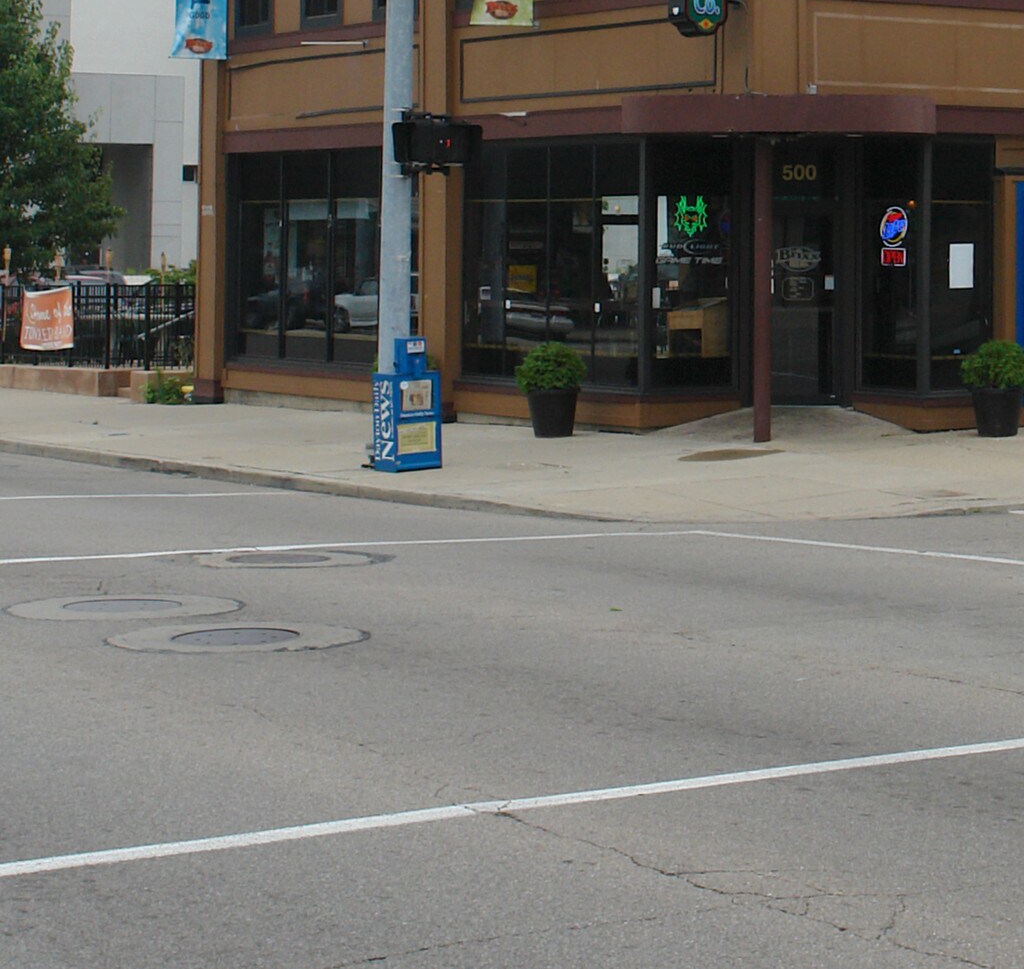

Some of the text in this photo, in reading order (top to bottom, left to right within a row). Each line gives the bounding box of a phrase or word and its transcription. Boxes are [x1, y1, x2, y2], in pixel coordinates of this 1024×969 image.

[782, 164, 817, 181] 500
[655, 256, 723, 265] GAME TIME
[380, 380, 395, 461] News
